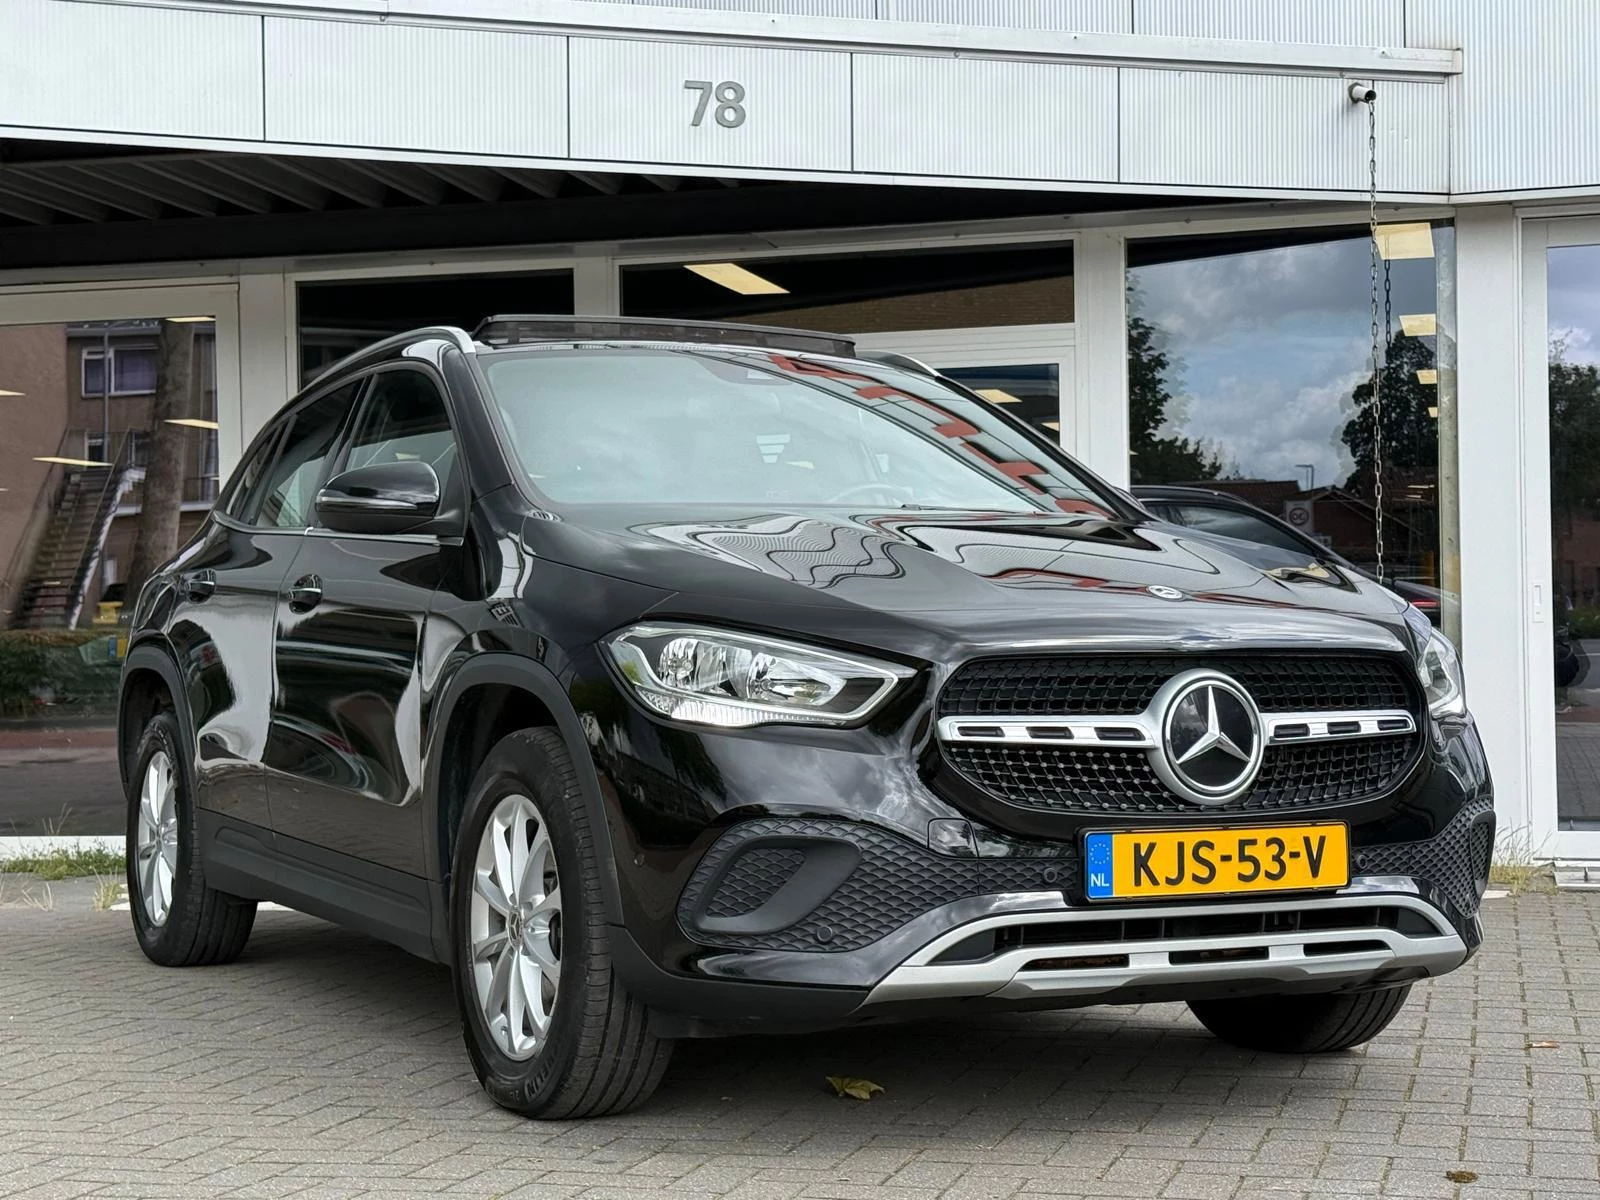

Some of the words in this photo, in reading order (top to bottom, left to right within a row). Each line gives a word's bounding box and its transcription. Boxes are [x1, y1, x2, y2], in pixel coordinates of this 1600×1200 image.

[684, 80, 746, 128] 78
[1090, 872, 1110, 888] NL
[1133, 835, 1326, 887] KJS-53-V
